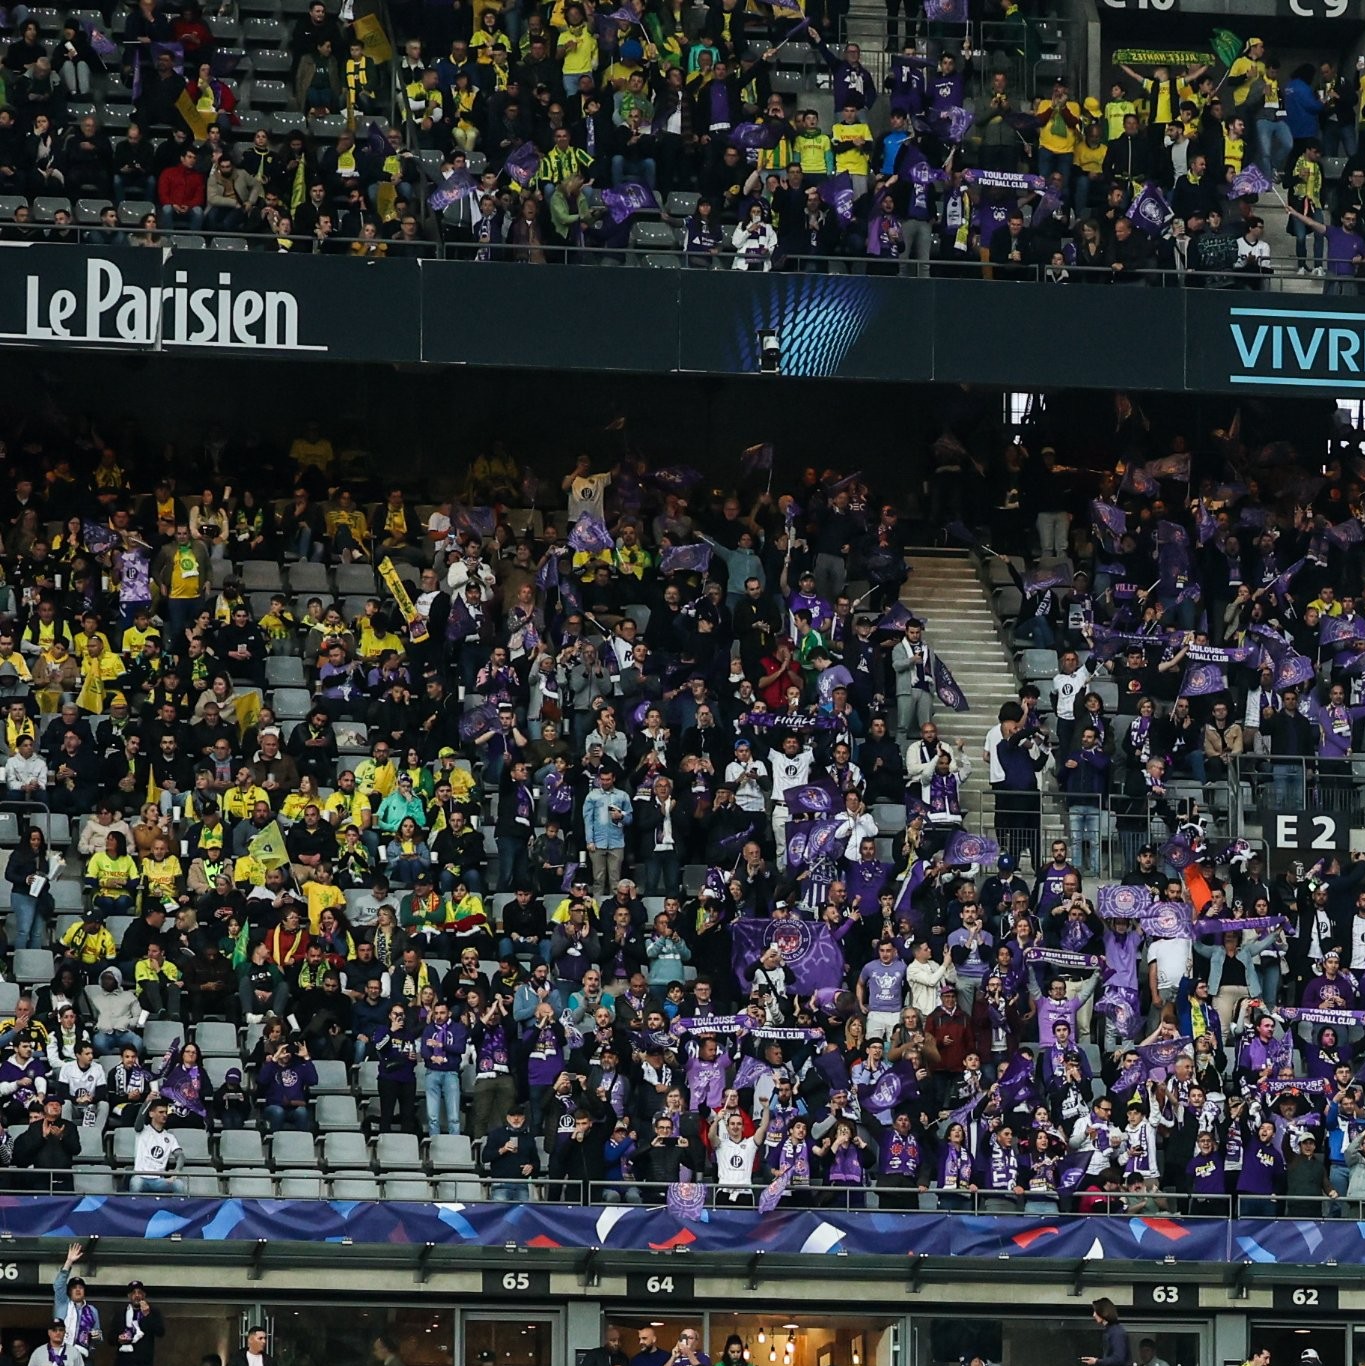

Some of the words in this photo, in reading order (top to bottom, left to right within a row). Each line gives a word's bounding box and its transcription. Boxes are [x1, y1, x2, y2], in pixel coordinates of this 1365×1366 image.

[983, 170, 1024, 182] TOULOUSE
[978, 177, 1010, 188] FOOTBALL
[1011, 180, 1029, 190] CLUB
[27, 275, 78, 339] Le
[87, 257, 299, 347] Parisien
[1189, 644, 1225, 655] OULOUSE
[1211, 654, 1228, 662] CLUB
[774, 715, 816, 727] FINALE
[692, 1015, 736, 1027] TOULOUSE
[1301, 1013, 1337, 1024] FOOTBALL
[1337, 1016, 1357, 1026] CLUB
[724, 1024, 742, 1034] CLUB
[786, 1030, 805, 1040] CLUB
[502, 1272, 530, 1290] 65
[646, 1275, 675, 1293] 64
[1152, 1285, 1180, 1303] 63
[1292, 1288, 1319, 1306] 62
